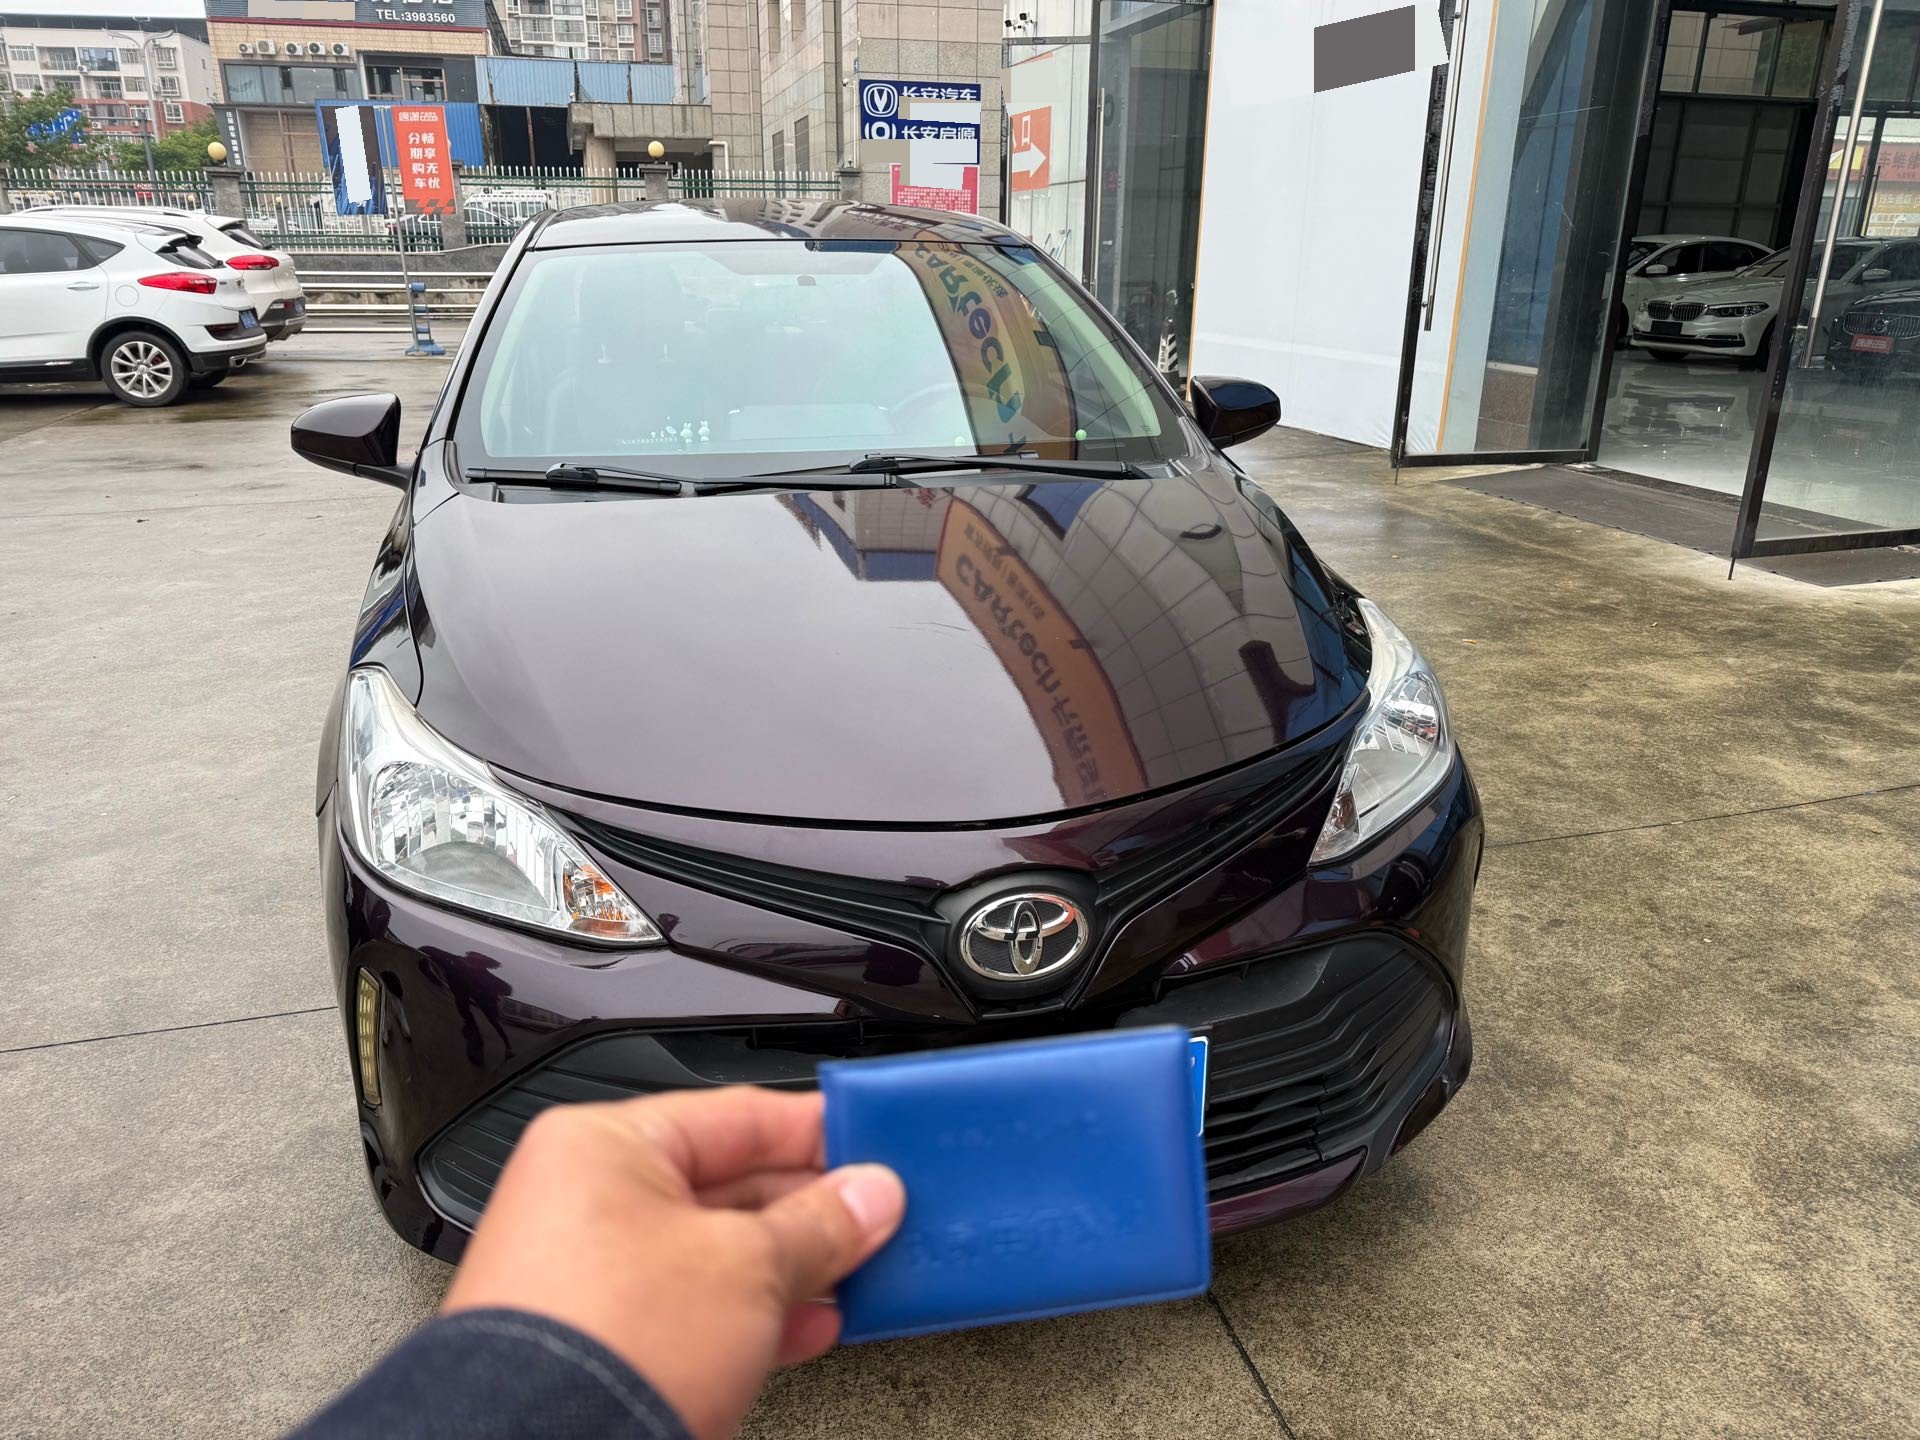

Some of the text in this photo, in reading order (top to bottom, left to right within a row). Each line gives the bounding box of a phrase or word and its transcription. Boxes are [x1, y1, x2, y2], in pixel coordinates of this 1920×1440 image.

[376, 9, 455, 23] TEL:3983560
[901, 86, 977, 100] 长安汽车
[901, 125, 976, 139] 长安启源
[1012, 115, 1031, 149] 口
[408, 132, 428, 189] 分期购车
[421, 132, 440, 189] 畅享无忧
[1866, 151, 1920, 170] 车维修
